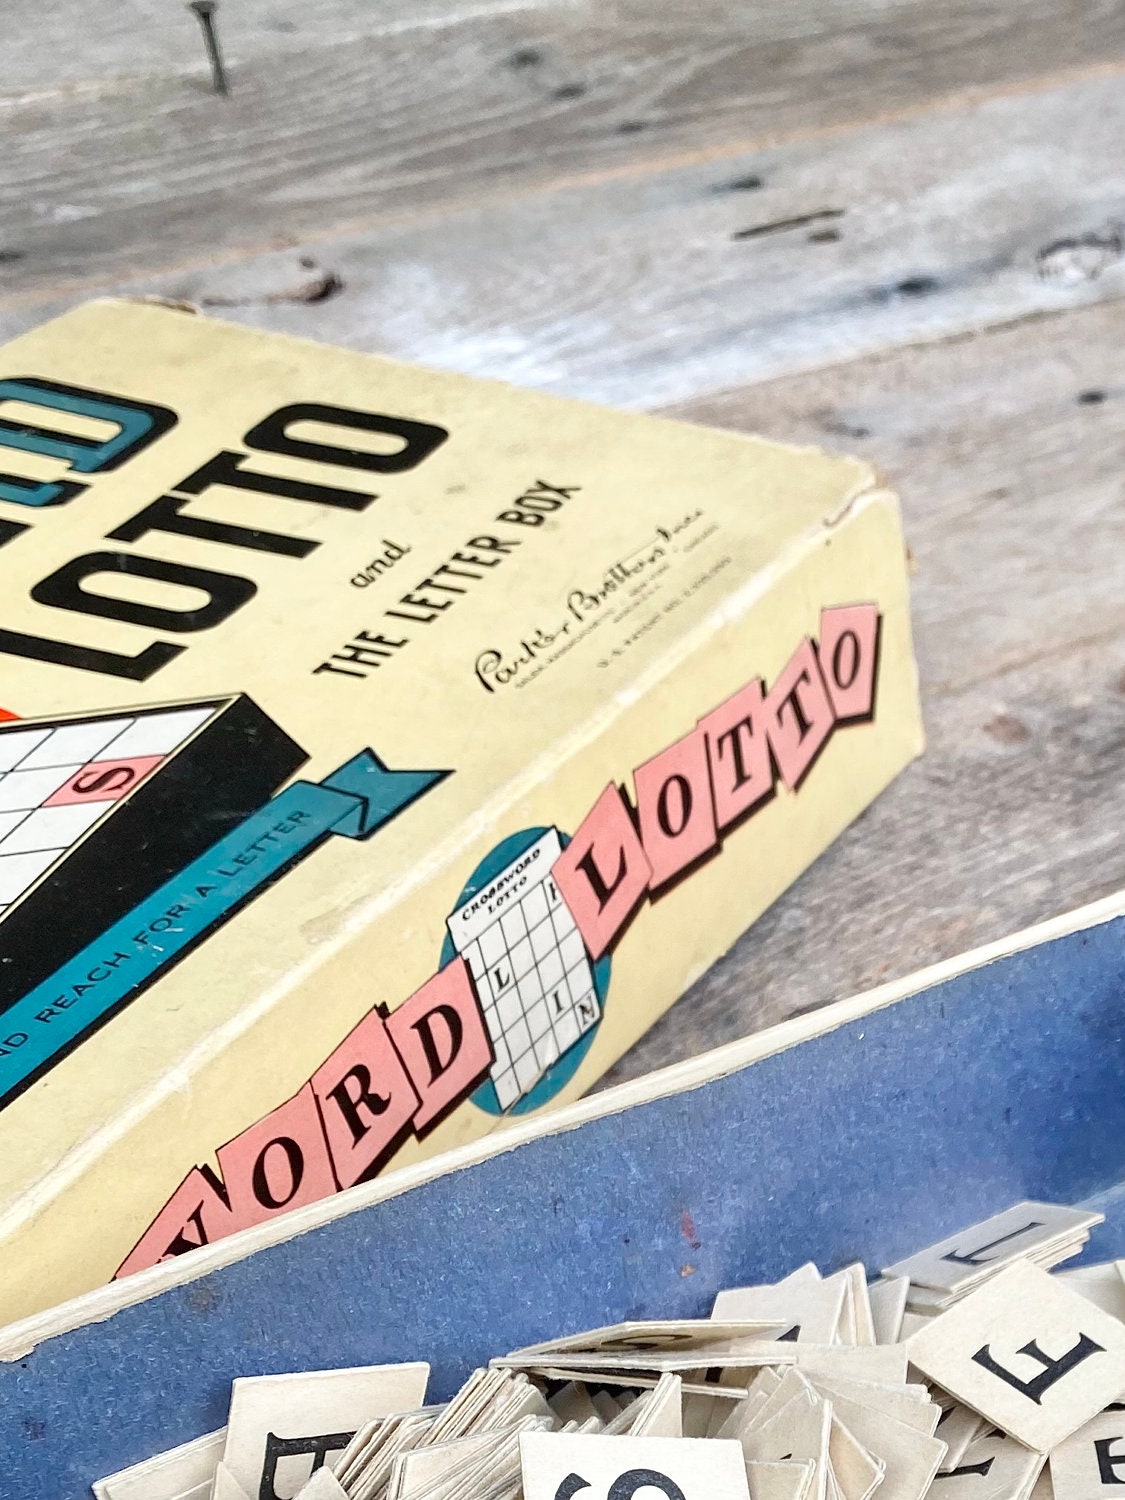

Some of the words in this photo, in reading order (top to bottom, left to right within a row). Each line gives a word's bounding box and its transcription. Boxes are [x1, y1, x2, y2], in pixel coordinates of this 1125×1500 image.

[0, 403, 449, 683] LOTTO
[312, 630, 410, 679] THE
[385, 535, 521, 625] LETTER
[496, 477, 582, 527] BOX
[350, 539, 411, 589] and
[475, 622, 571, 693] Parker
[71, 766, 136, 794] S
[575, 630, 862, 916] LOTTO
[34, 952, 132, 1023] REACH
[133, 904, 191, 947] FOR
[197, 884, 218, 898] A
[217, 809, 311, 877] LETTER
[486, 875, 529, 915] LOTTO
[971, 1332, 1107, 1405] F
